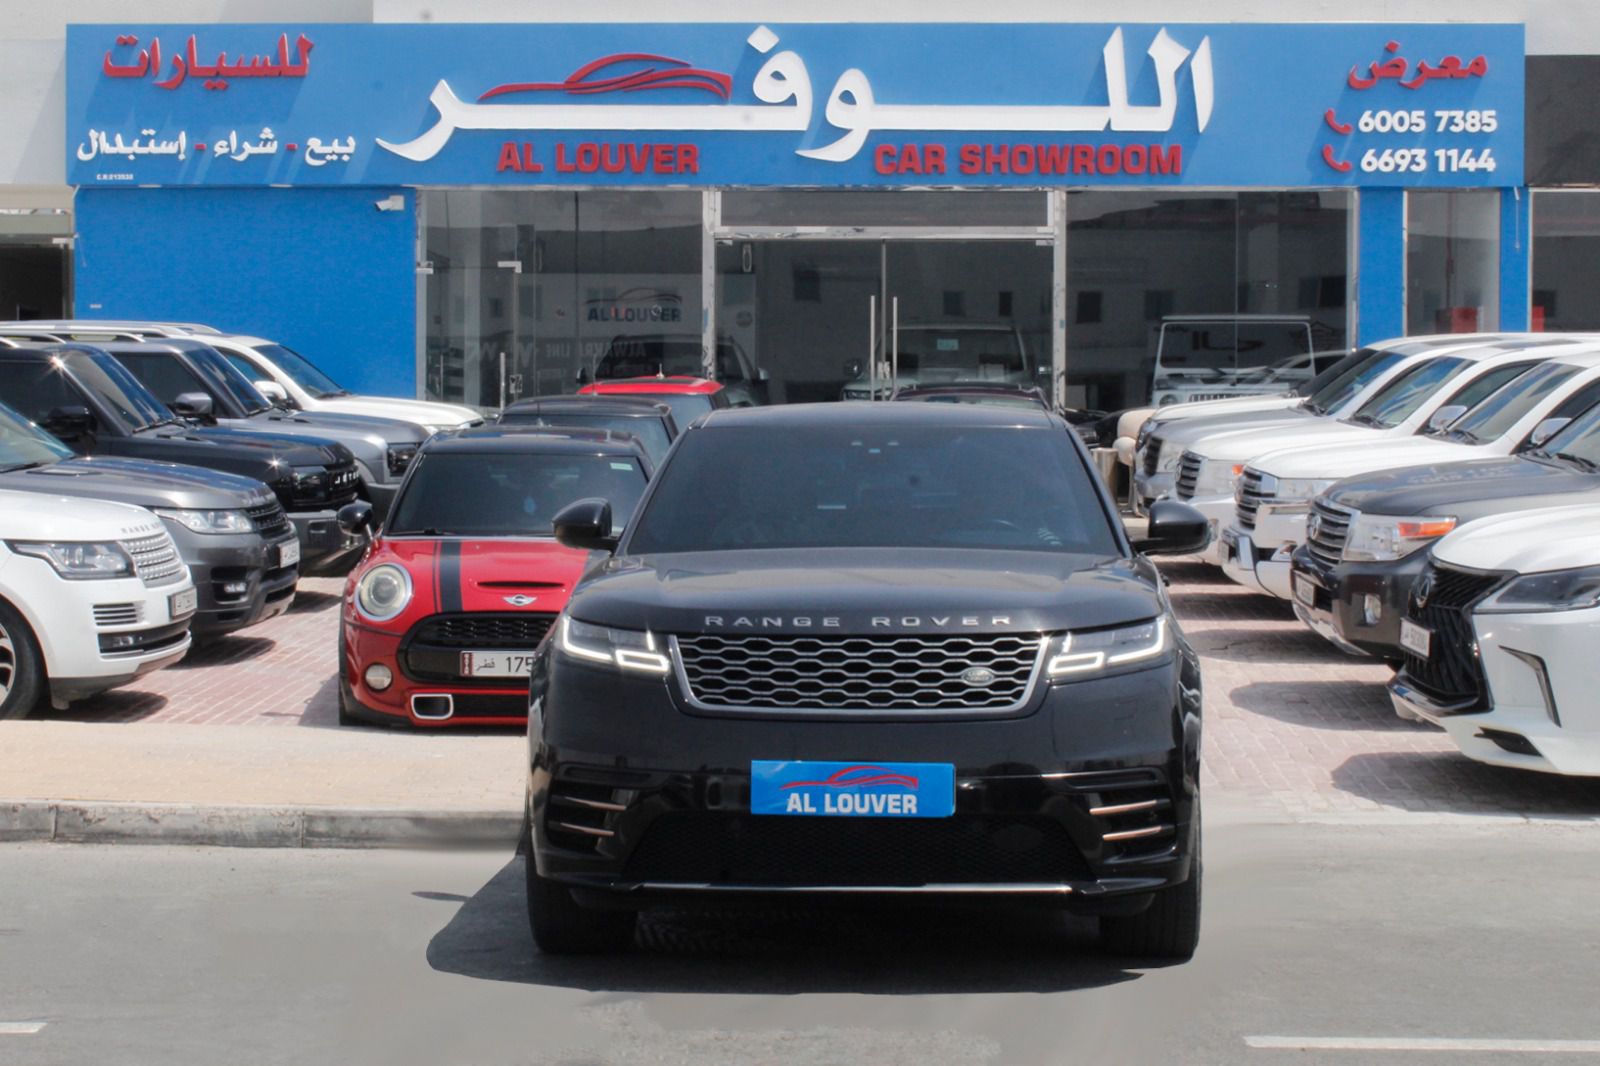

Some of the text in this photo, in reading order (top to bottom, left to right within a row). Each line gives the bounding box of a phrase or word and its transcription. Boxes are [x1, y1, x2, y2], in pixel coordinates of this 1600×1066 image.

[103, 33, 313, 90] للسيارات
[1348, 41, 1488, 90] معرض
[376, 25, 1214, 164] اللوفر
[1358, 110, 1498, 133] 6005 7385
[77, 127, 356, 166] بيع شراء إستبدال
[497, 142, 699, 174] AL LOUVER
[874, 143, 1182, 175] CAR SHOWROOM
[1360, 148, 1497, 173] 6693 1144
[704, 615, 1010, 627] RANGE ROVER
[786, 792, 918, 814] AL LOUVER
